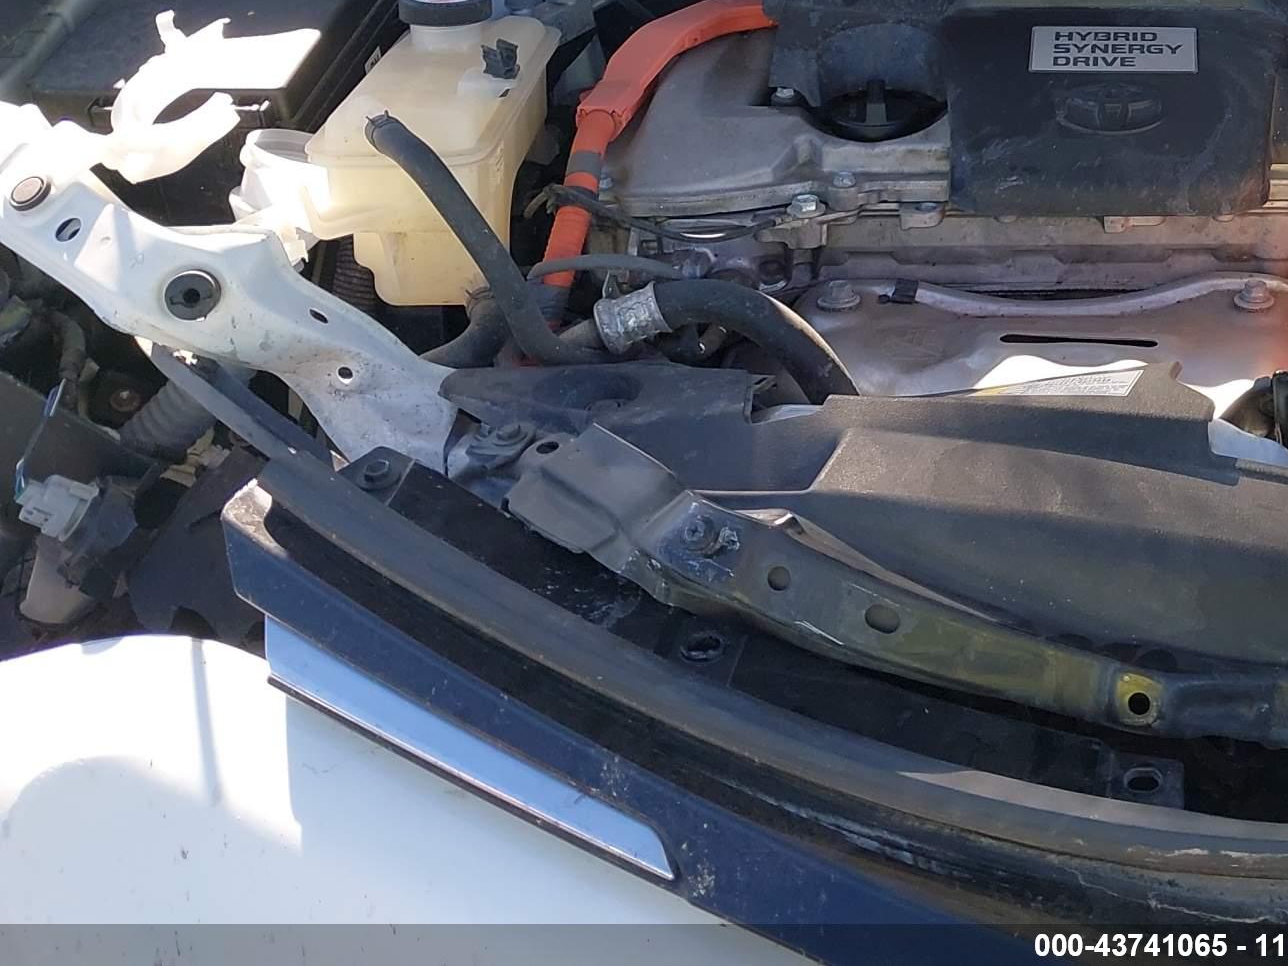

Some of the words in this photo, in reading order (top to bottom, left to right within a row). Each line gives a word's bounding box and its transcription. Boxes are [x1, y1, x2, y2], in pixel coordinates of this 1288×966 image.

[1054, 31, 1158, 42] HYBRID
[1053, 43, 1183, 55] SYNERGY
[1053, 56, 1137, 67] DRIVE
